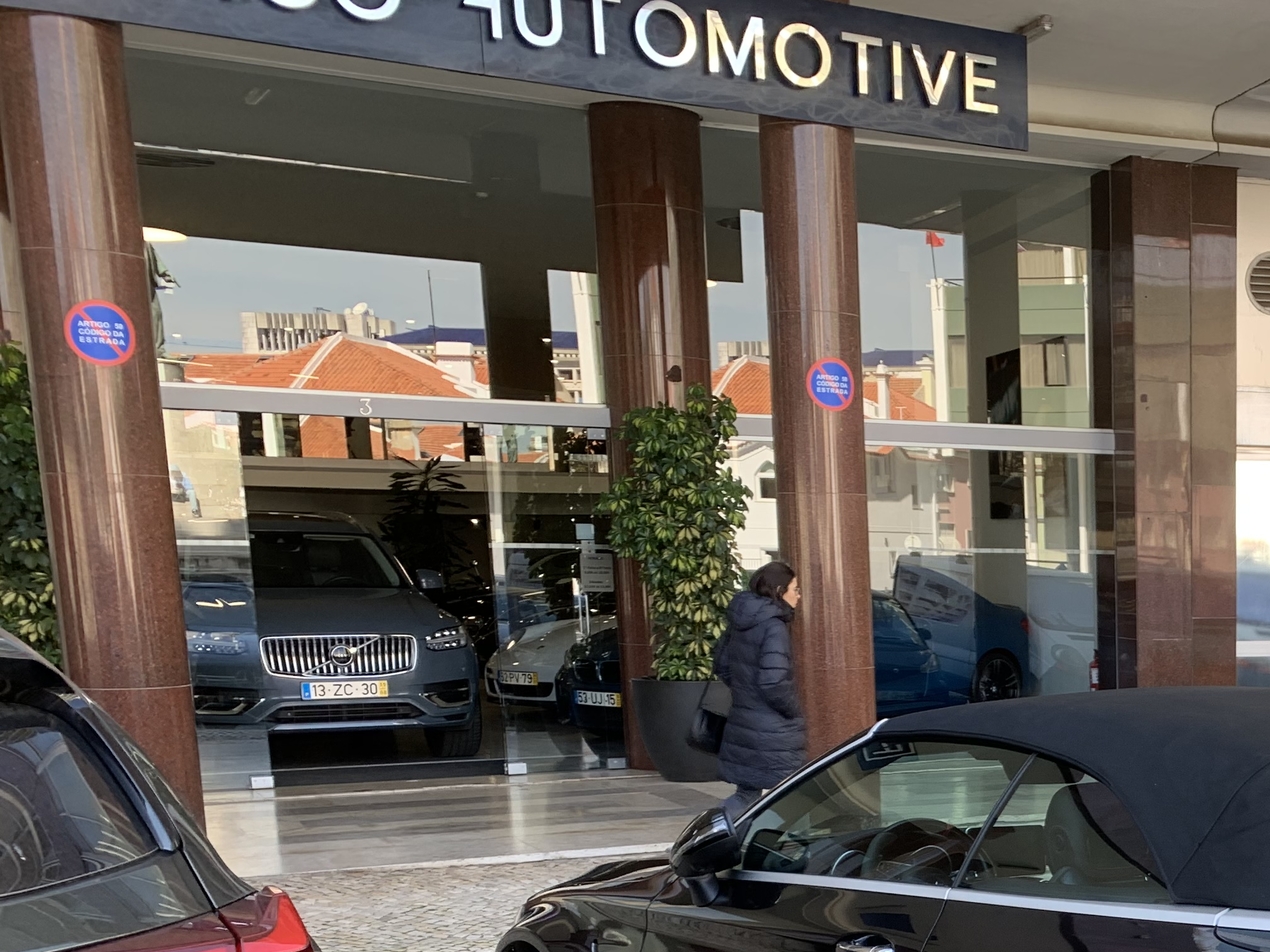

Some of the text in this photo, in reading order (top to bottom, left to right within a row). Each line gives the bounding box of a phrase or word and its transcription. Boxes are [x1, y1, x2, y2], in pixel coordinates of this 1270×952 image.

[462, 0, 999, 115] AUTOMOTIVE
[77, 320, 110, 329] ARTIGO
[112, 330, 125, 338] DA
[78, 335, 126, 346] ESTRADA
[816, 387, 849, 395] ESTRADA
[359, 398, 373, 416] 3
